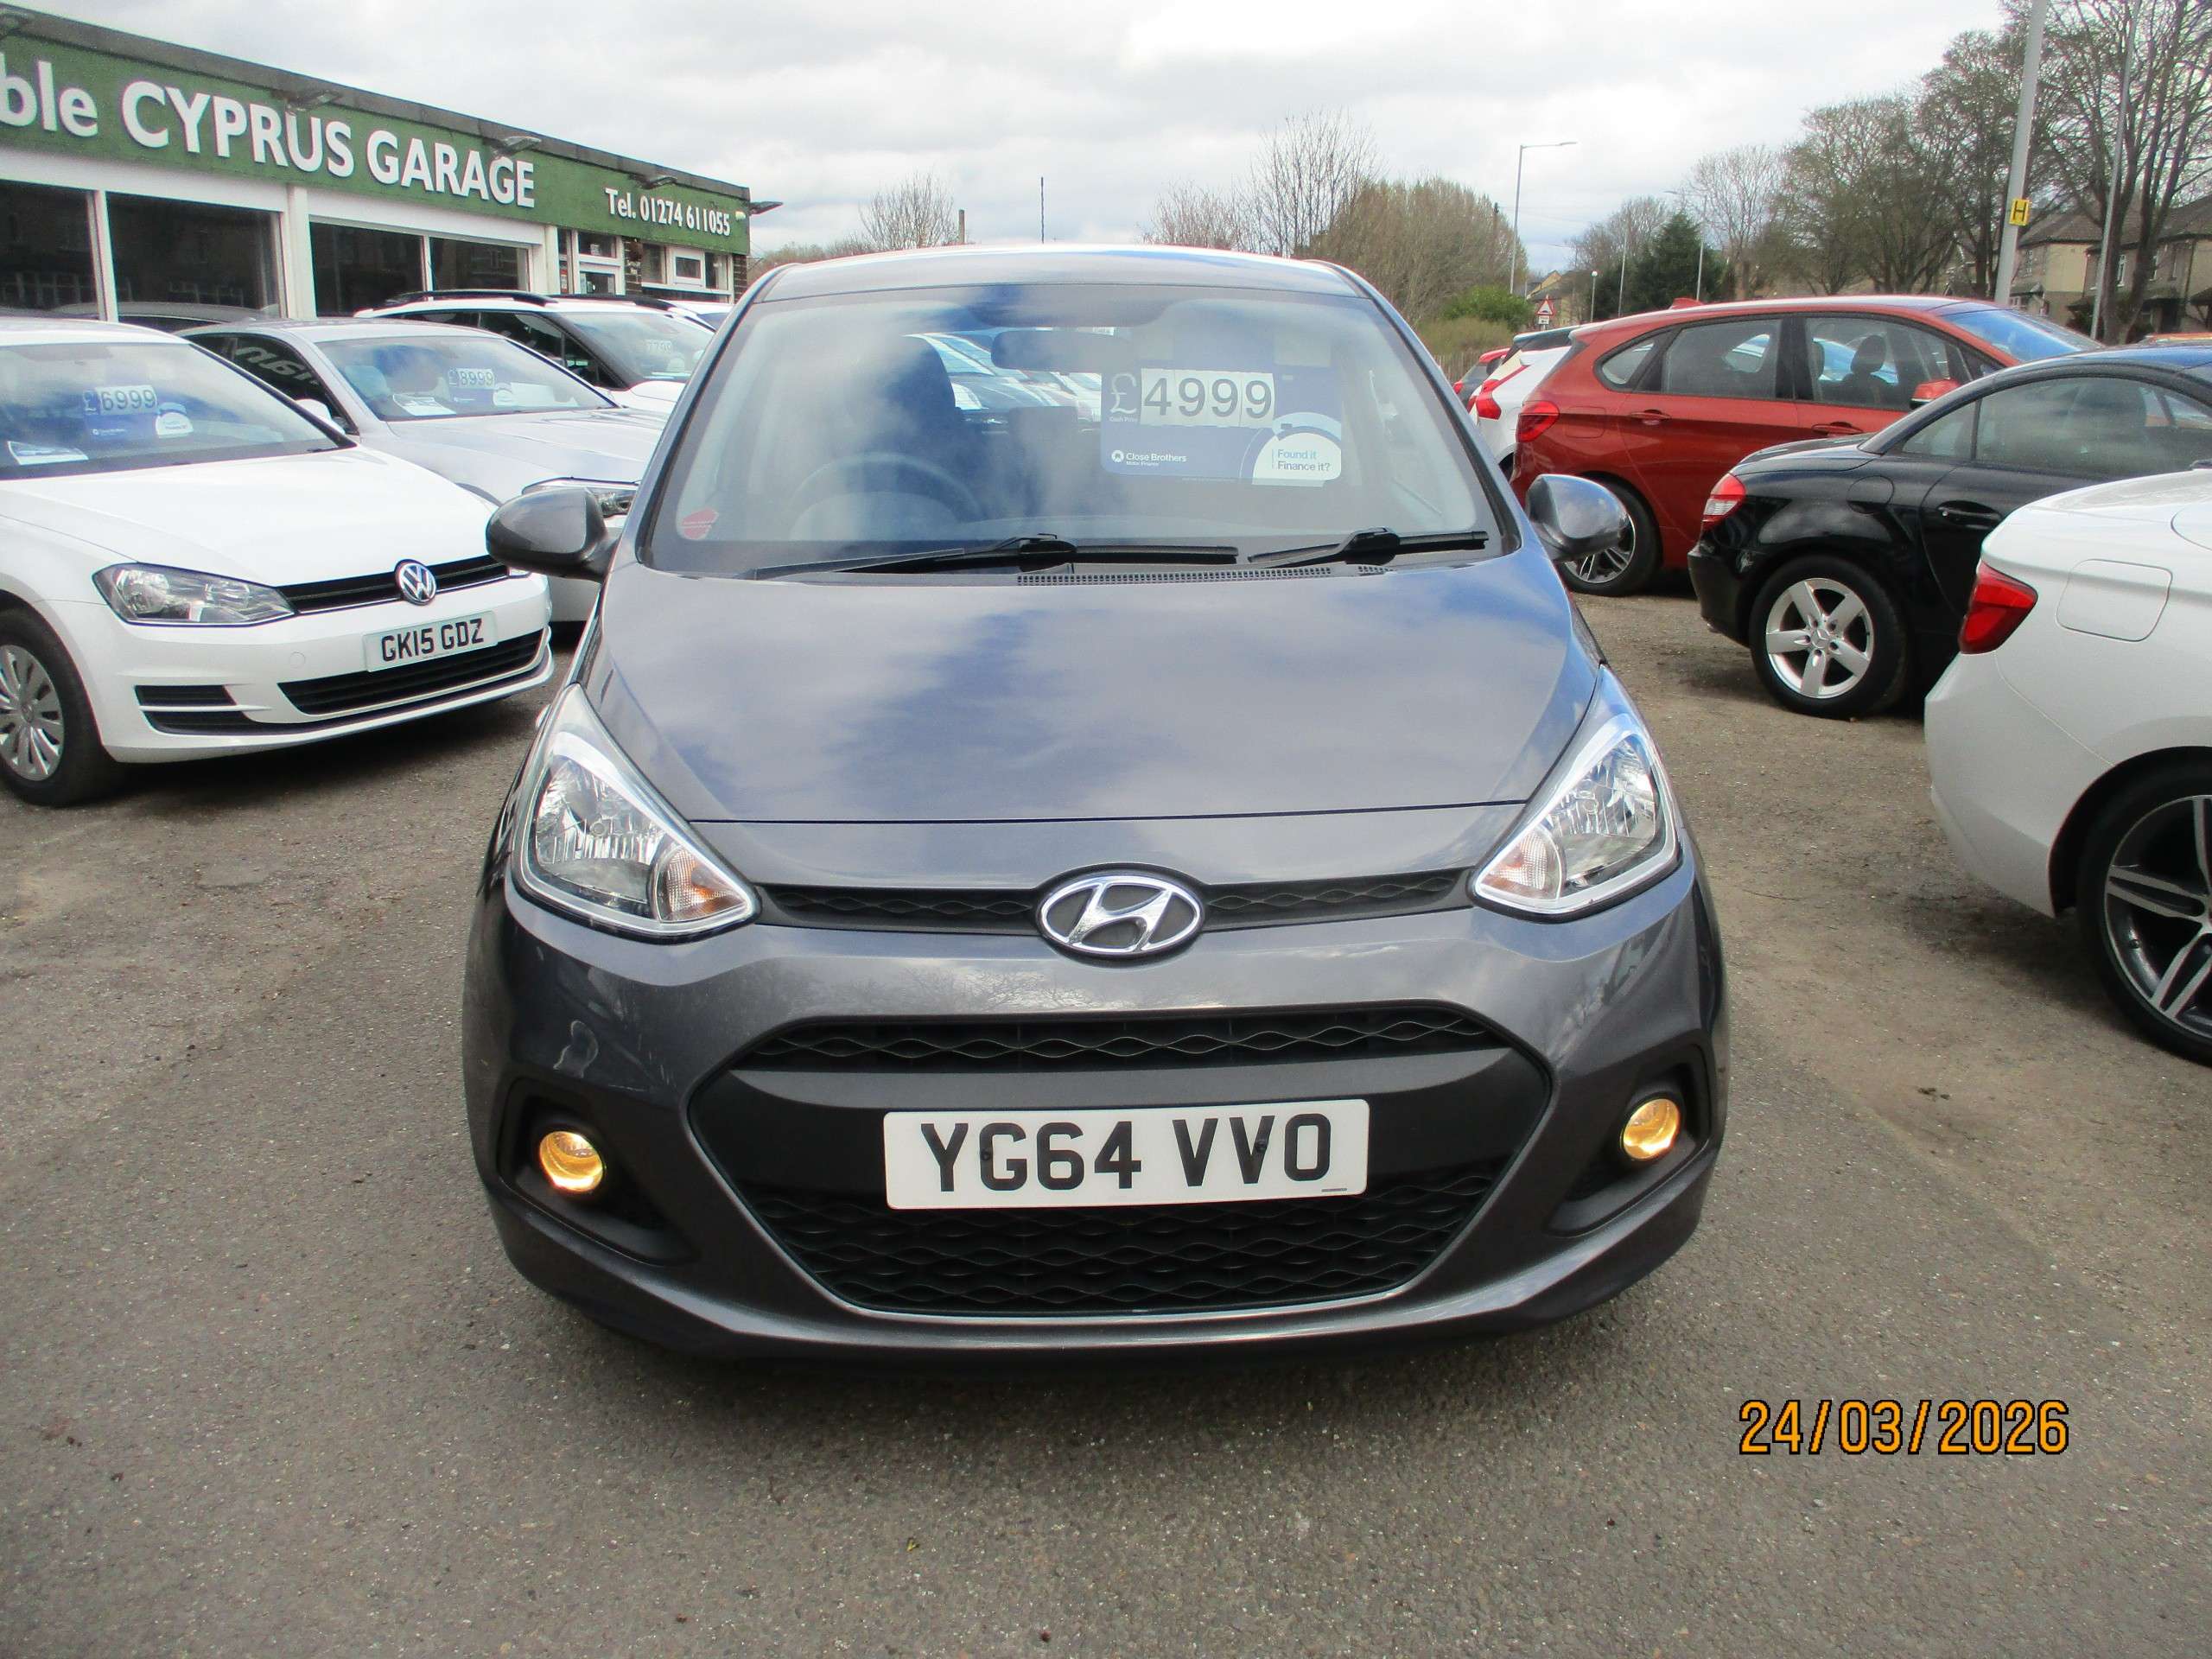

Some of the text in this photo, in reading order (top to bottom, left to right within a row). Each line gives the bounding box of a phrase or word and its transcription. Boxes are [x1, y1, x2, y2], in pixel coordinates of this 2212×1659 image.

[0, 52, 535, 208] ble CYPRUS GARAGE
[605, 188, 731, 237] Tel. 01274 611055
[2012, 200, 2027, 222] H
[1126, 452, 1188, 463] Close Brothers
[1277, 448, 1317, 461] Found it
[1277, 461, 1331, 472] Finance it?
[381, 618, 485, 662] GK15 GDZ
[920, 1113, 1332, 1192] YG64 VVO
